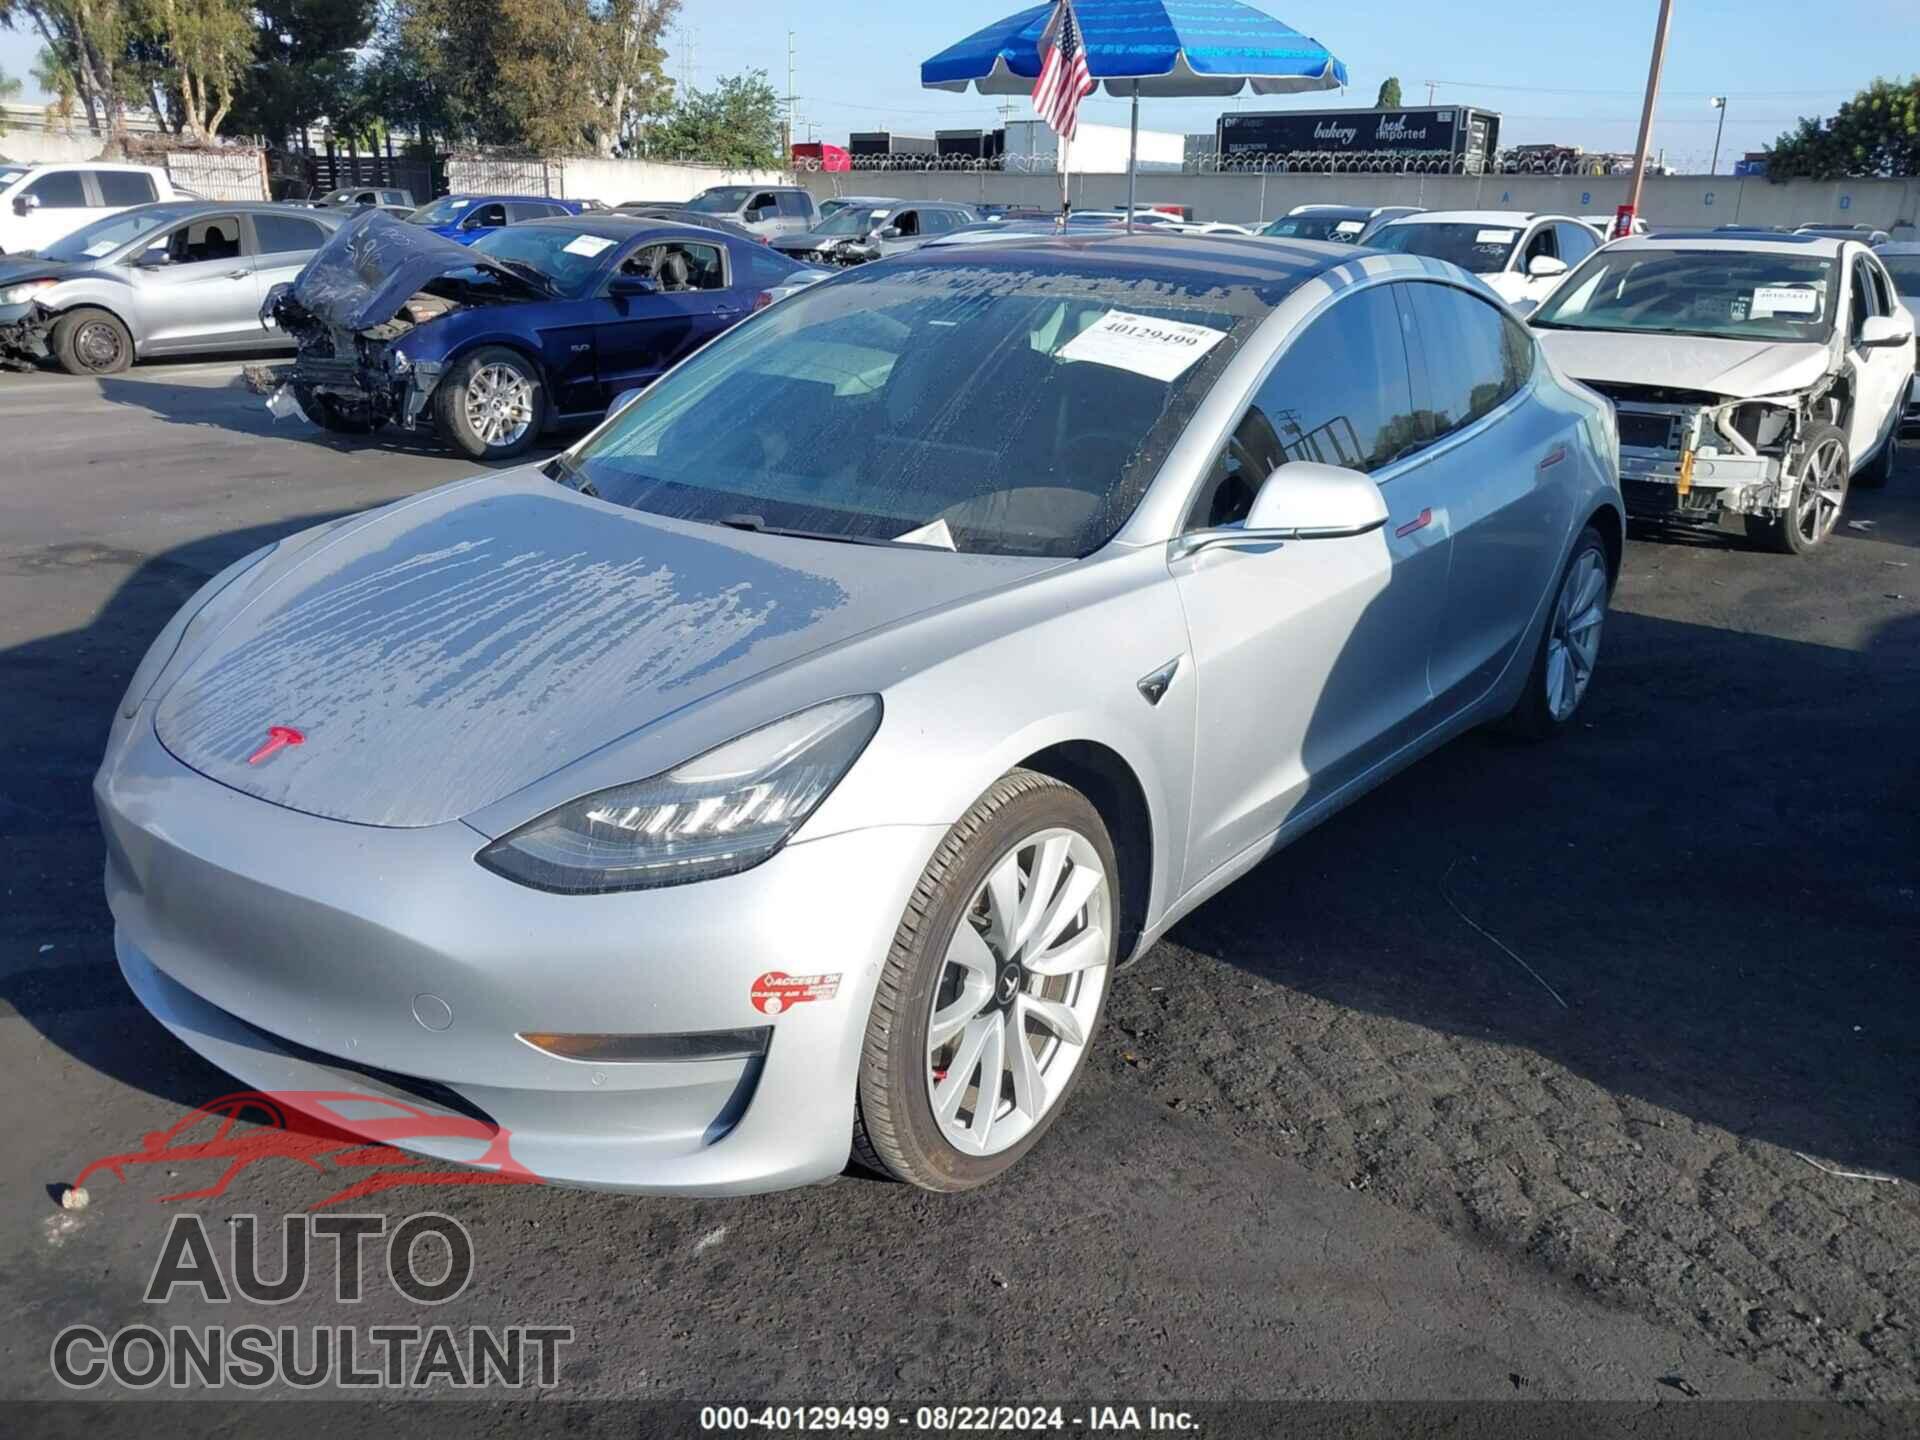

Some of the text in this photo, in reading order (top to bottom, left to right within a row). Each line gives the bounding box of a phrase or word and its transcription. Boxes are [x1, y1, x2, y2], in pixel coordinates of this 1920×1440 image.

[1314, 121, 1357, 145] bakery
[1376, 128, 1427, 141] imported
[1502, 192, 1510, 203] A
[1582, 192, 1591, 204] B
[1705, 192, 1714, 206] C
[1104, 322, 1198, 346] 40129499
